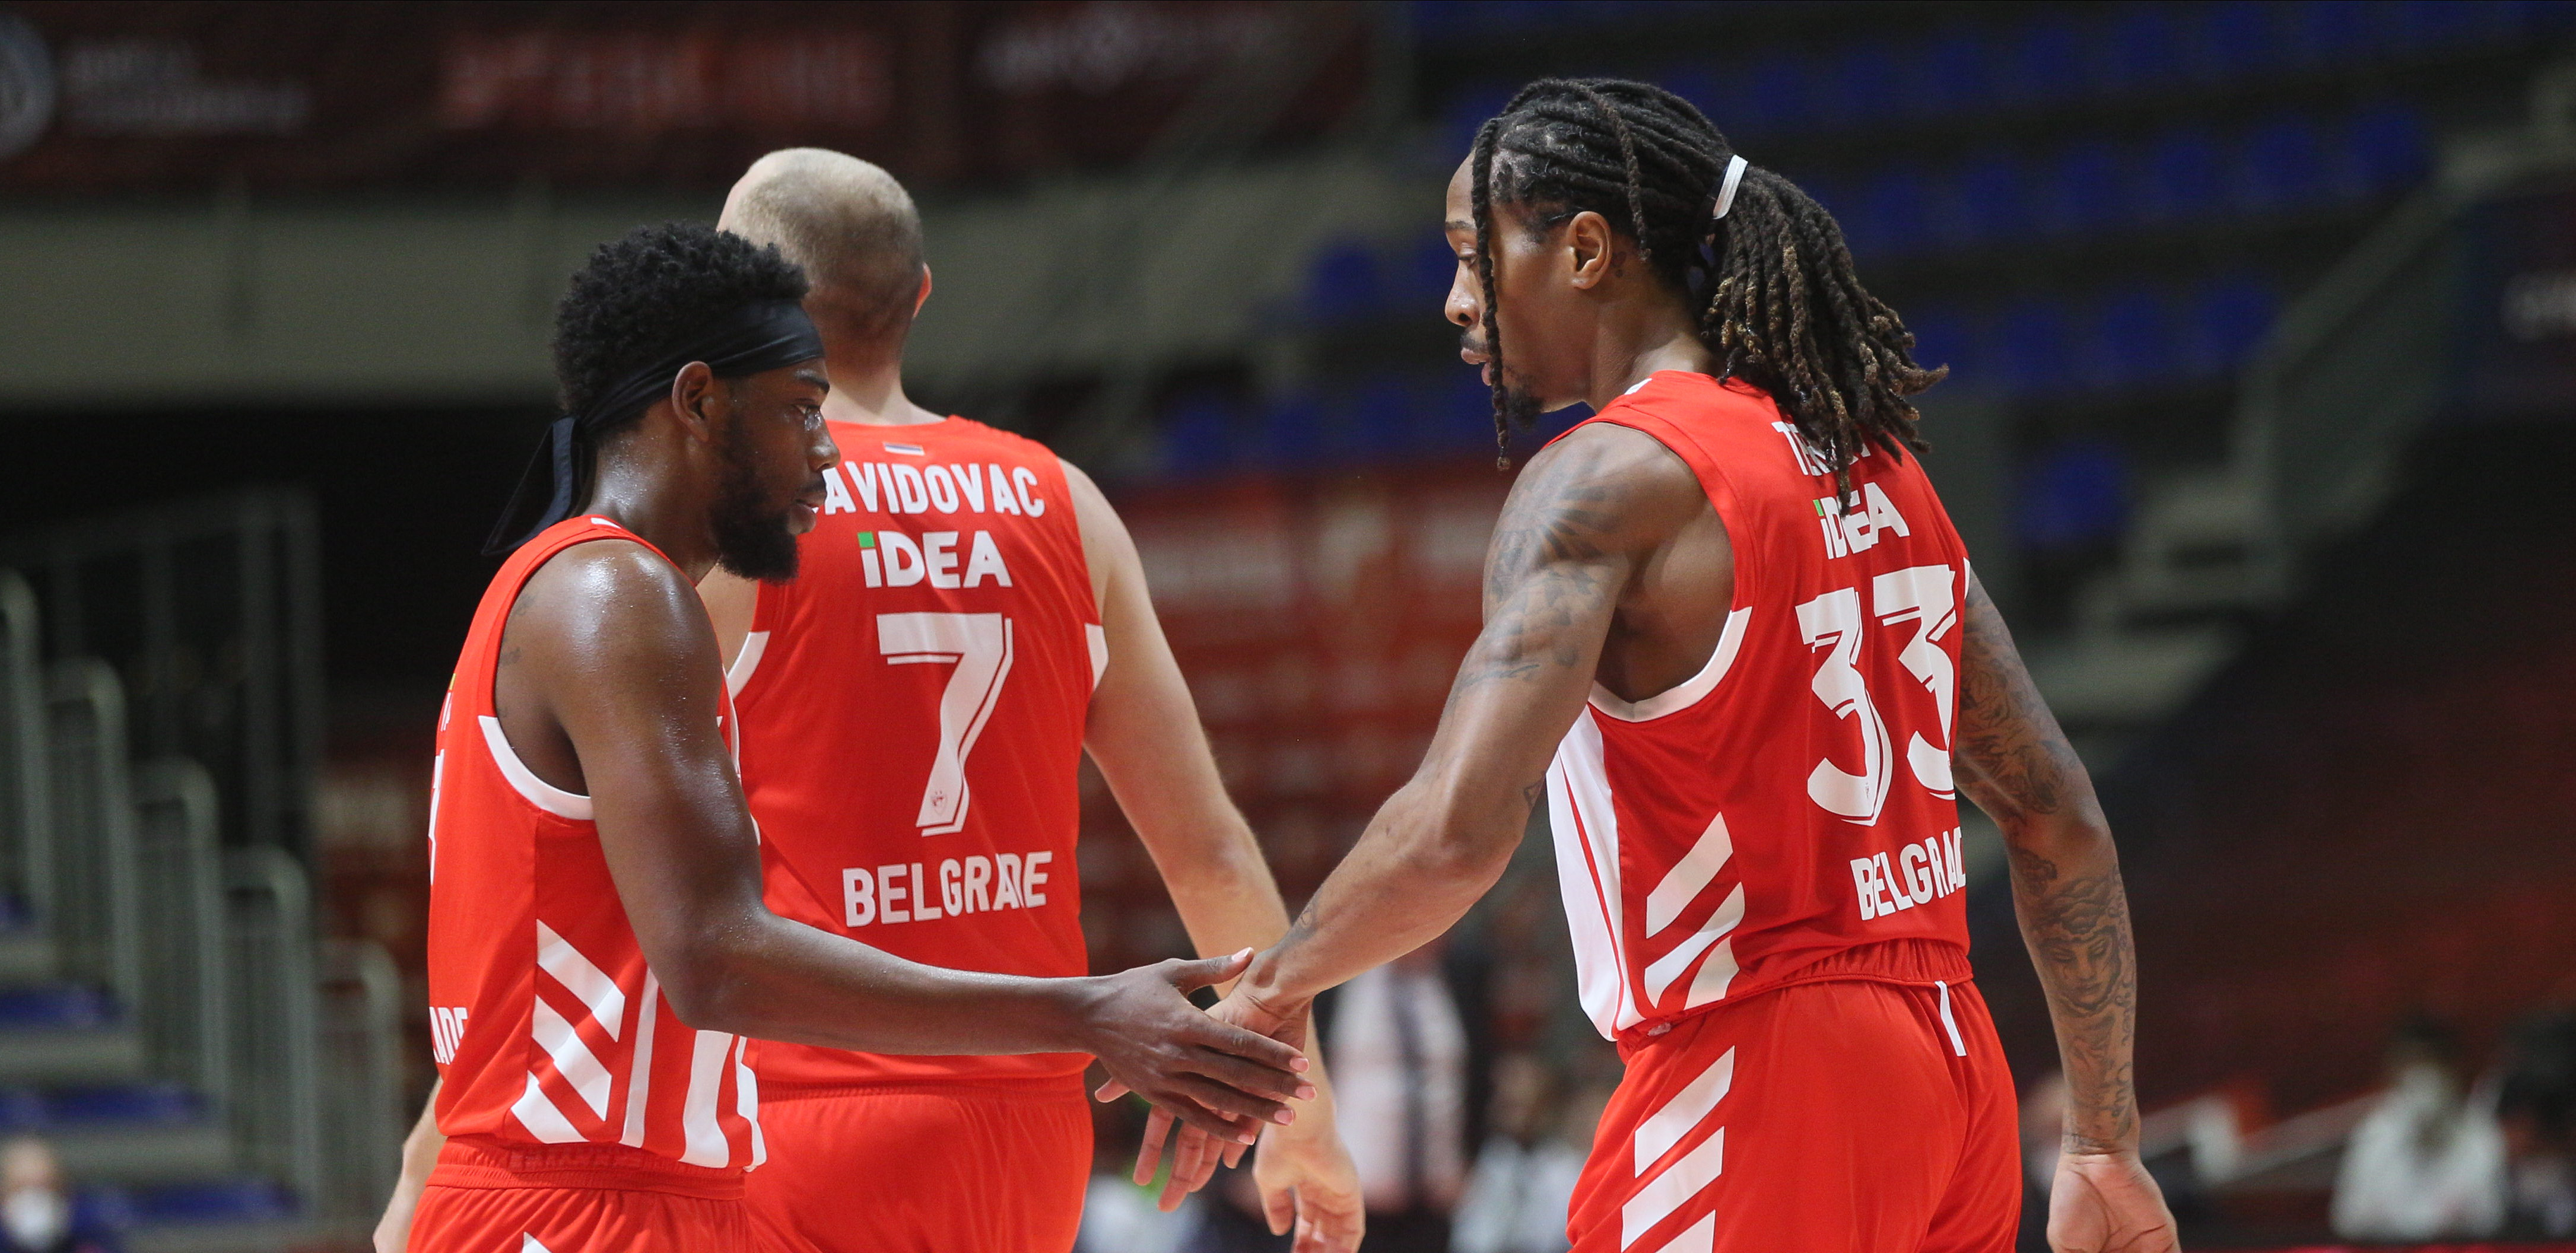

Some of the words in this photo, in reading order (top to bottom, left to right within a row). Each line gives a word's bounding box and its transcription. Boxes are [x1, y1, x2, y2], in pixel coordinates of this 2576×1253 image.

[813, 462, 1045, 518] AVIDOVAC
[857, 530, 1012, 589] iDEA
[876, 612, 1014, 837] 7
[1795, 564, 1956, 826] 33
